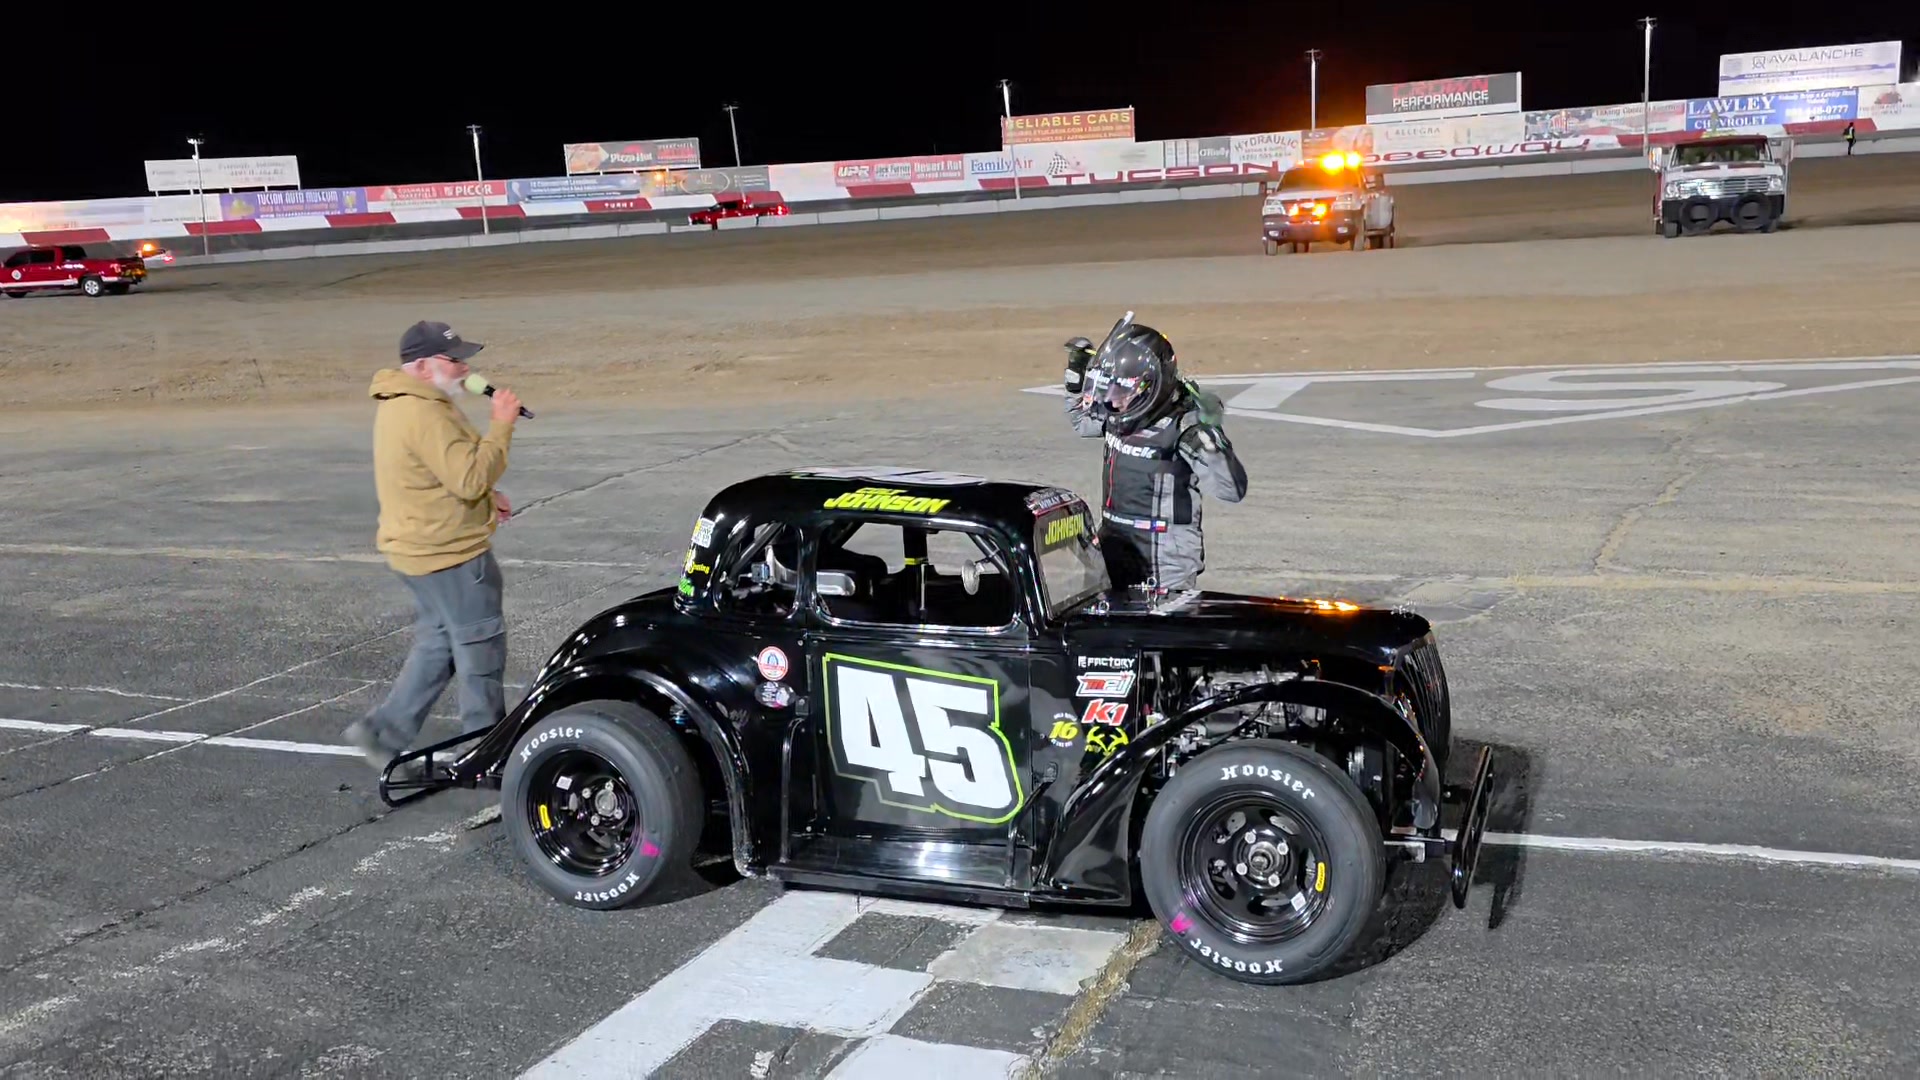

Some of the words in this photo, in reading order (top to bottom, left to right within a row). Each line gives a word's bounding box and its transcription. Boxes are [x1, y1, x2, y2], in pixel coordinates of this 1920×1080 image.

[1769, 48, 1864, 64] AVALANCHE
[1392, 90, 1489, 107] PERFORMANCE
[1688, 96, 1776, 114] LAWLEY
[1087, 112, 1131, 124] CARS
[1694, 116, 1767, 130] CHVROLET
[1394, 127, 1441, 136] ALLEGRA
[1234, 134, 1299, 151] HYDRAULIC
[610, 152, 635, 163] Pizza
[636, 152, 652, 161] Hut
[1052, 160, 1278, 185] TUCSON
[1364, 139, 1590, 164] eedway
[838, 166, 870, 177] UPR
[257, 193, 283, 205] TUCSON
[455, 184, 493, 197] PICOR
[823, 492, 951, 515] JOHNSON
[1045, 512, 1085, 545] JOHNSON
[1081, 698, 1129, 726] K1
[837, 665, 1012, 809] 45
[1049, 721, 1078, 740] 16
[519, 726, 583, 763] Hoosier
[1220, 764, 1315, 800] Hoosier
[575, 869, 640, 902] Hoosier
[1190, 938, 1283, 974] Hoosier
